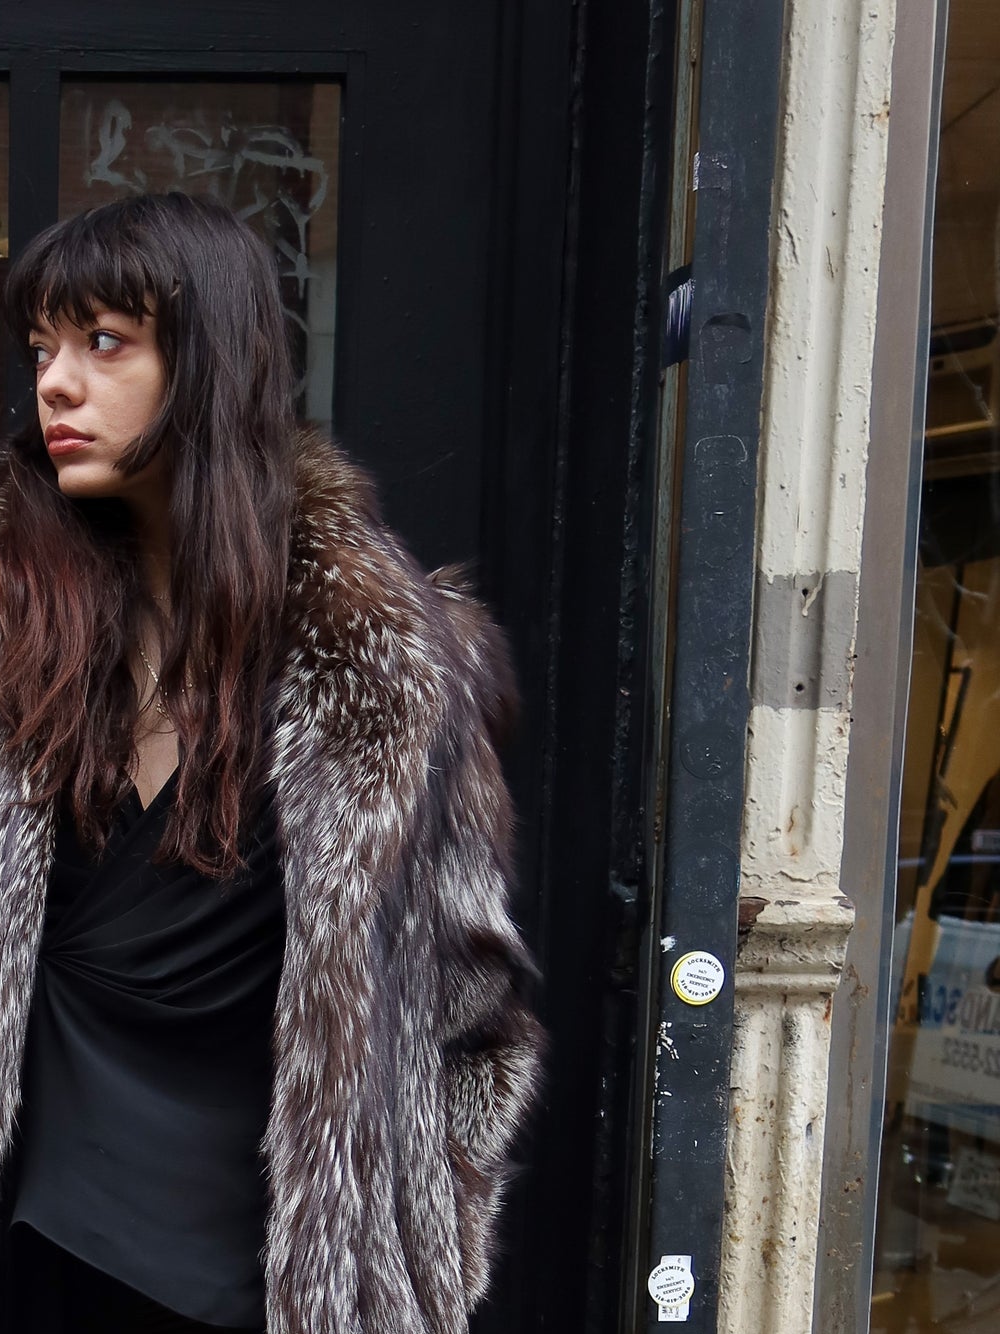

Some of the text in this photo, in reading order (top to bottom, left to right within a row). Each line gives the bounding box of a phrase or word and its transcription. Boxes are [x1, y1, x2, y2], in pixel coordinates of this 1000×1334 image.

[687, 958, 721, 973] LOCKSMITH
[686, 972, 715, 983] EMERGENCY
[651, 1265, 685, 1280] LOCKSMITH
[656, 1280, 685, 1290] EMERGENCY
